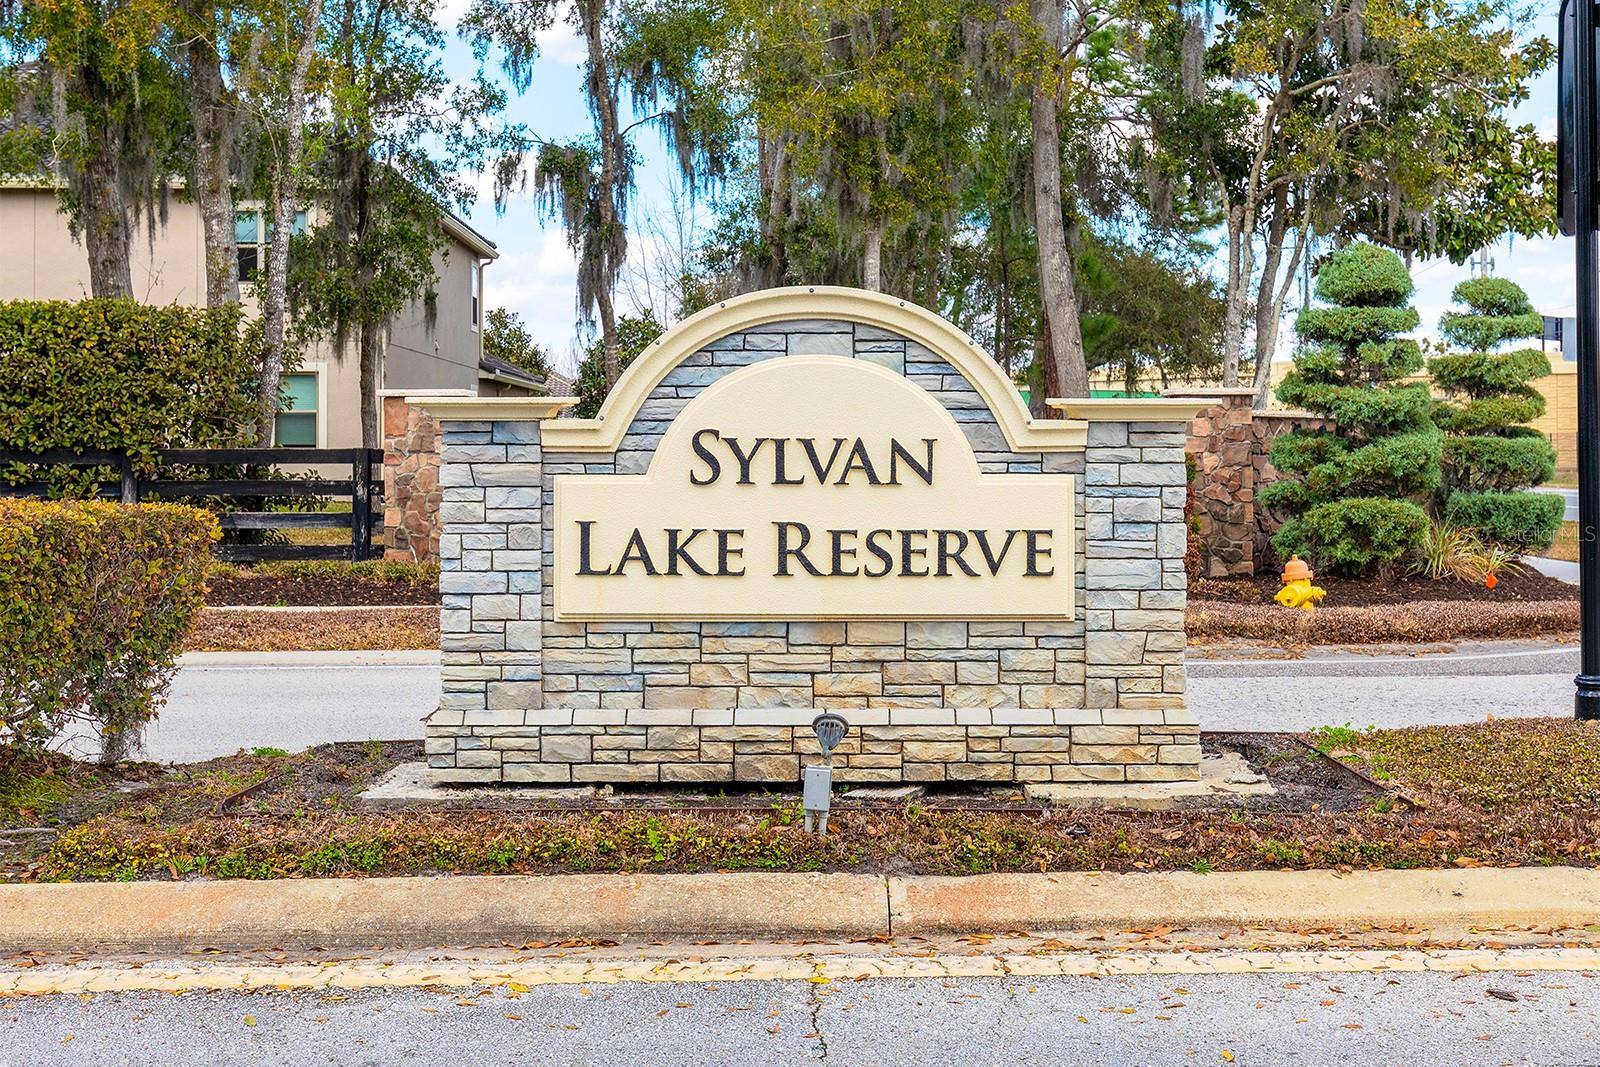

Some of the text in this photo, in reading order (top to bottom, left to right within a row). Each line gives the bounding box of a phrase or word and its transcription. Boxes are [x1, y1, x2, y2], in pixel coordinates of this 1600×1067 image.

[690, 429, 937, 486] SYLVAN
[575, 521, 1055, 577] LAKE RESERVE
